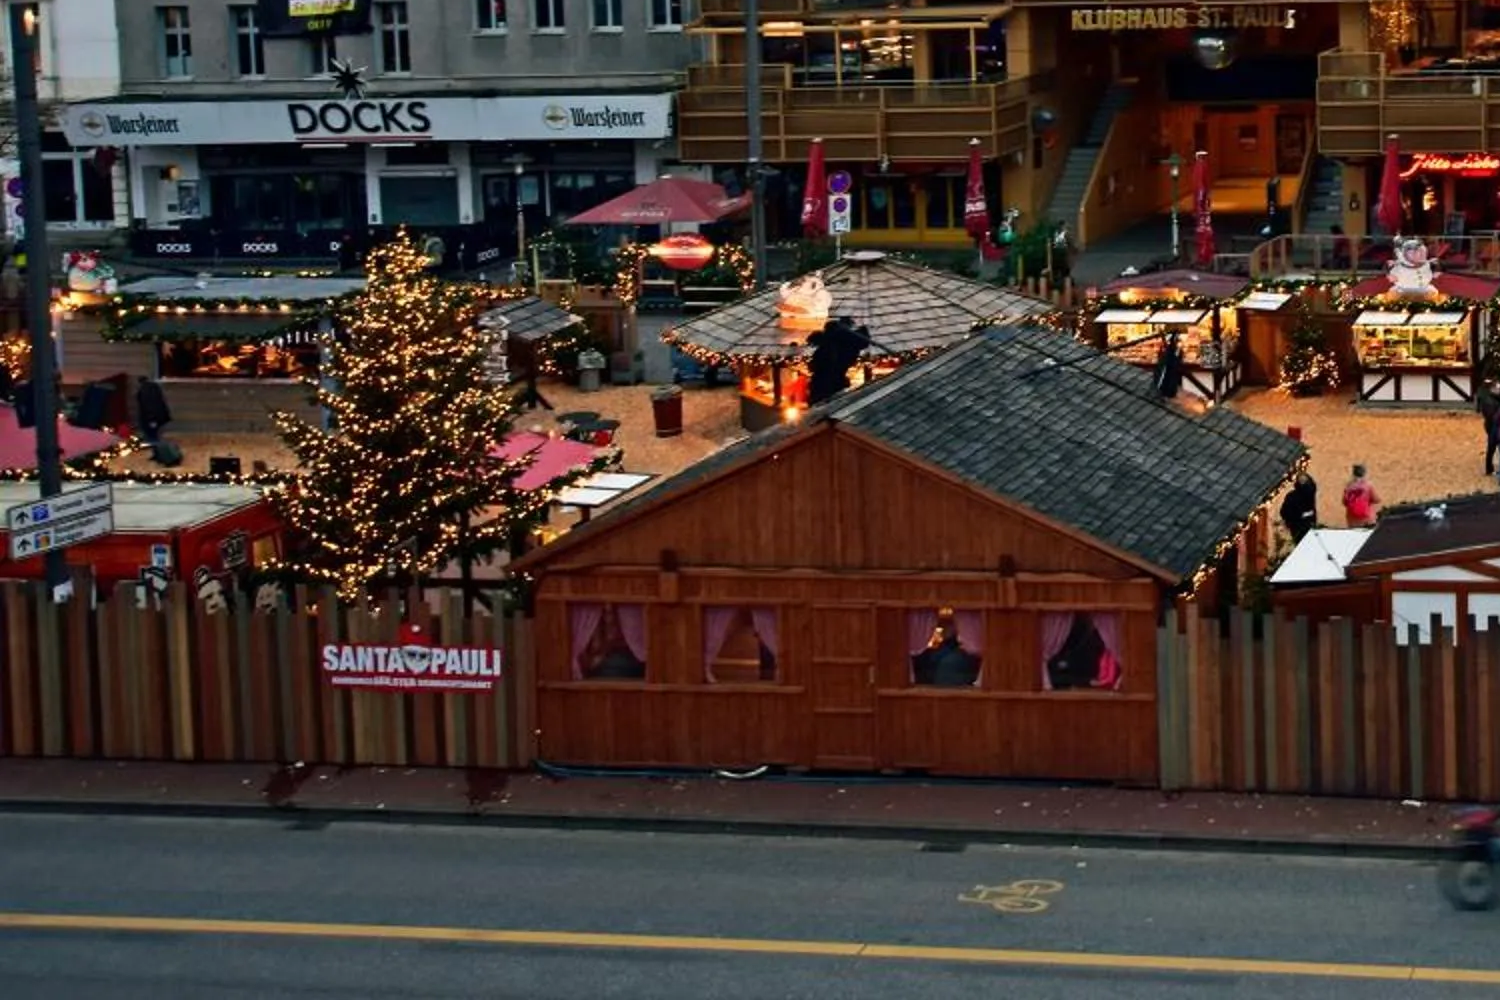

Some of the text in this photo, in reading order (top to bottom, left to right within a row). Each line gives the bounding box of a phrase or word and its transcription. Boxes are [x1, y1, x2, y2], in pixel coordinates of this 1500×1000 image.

[1071, 8, 1187, 31] KLUBHAUS
[1198, 6, 1227, 29] ST.
[106, 112, 180, 137] Warsteiner
[287, 101, 432, 134] DOCKS
[570, 105, 646, 129] Warsteiner
[157, 243, 191, 253] DOCKS
[242, 242, 278, 253] DOCKS
[322, 644, 501, 676] SANTA PAULI
